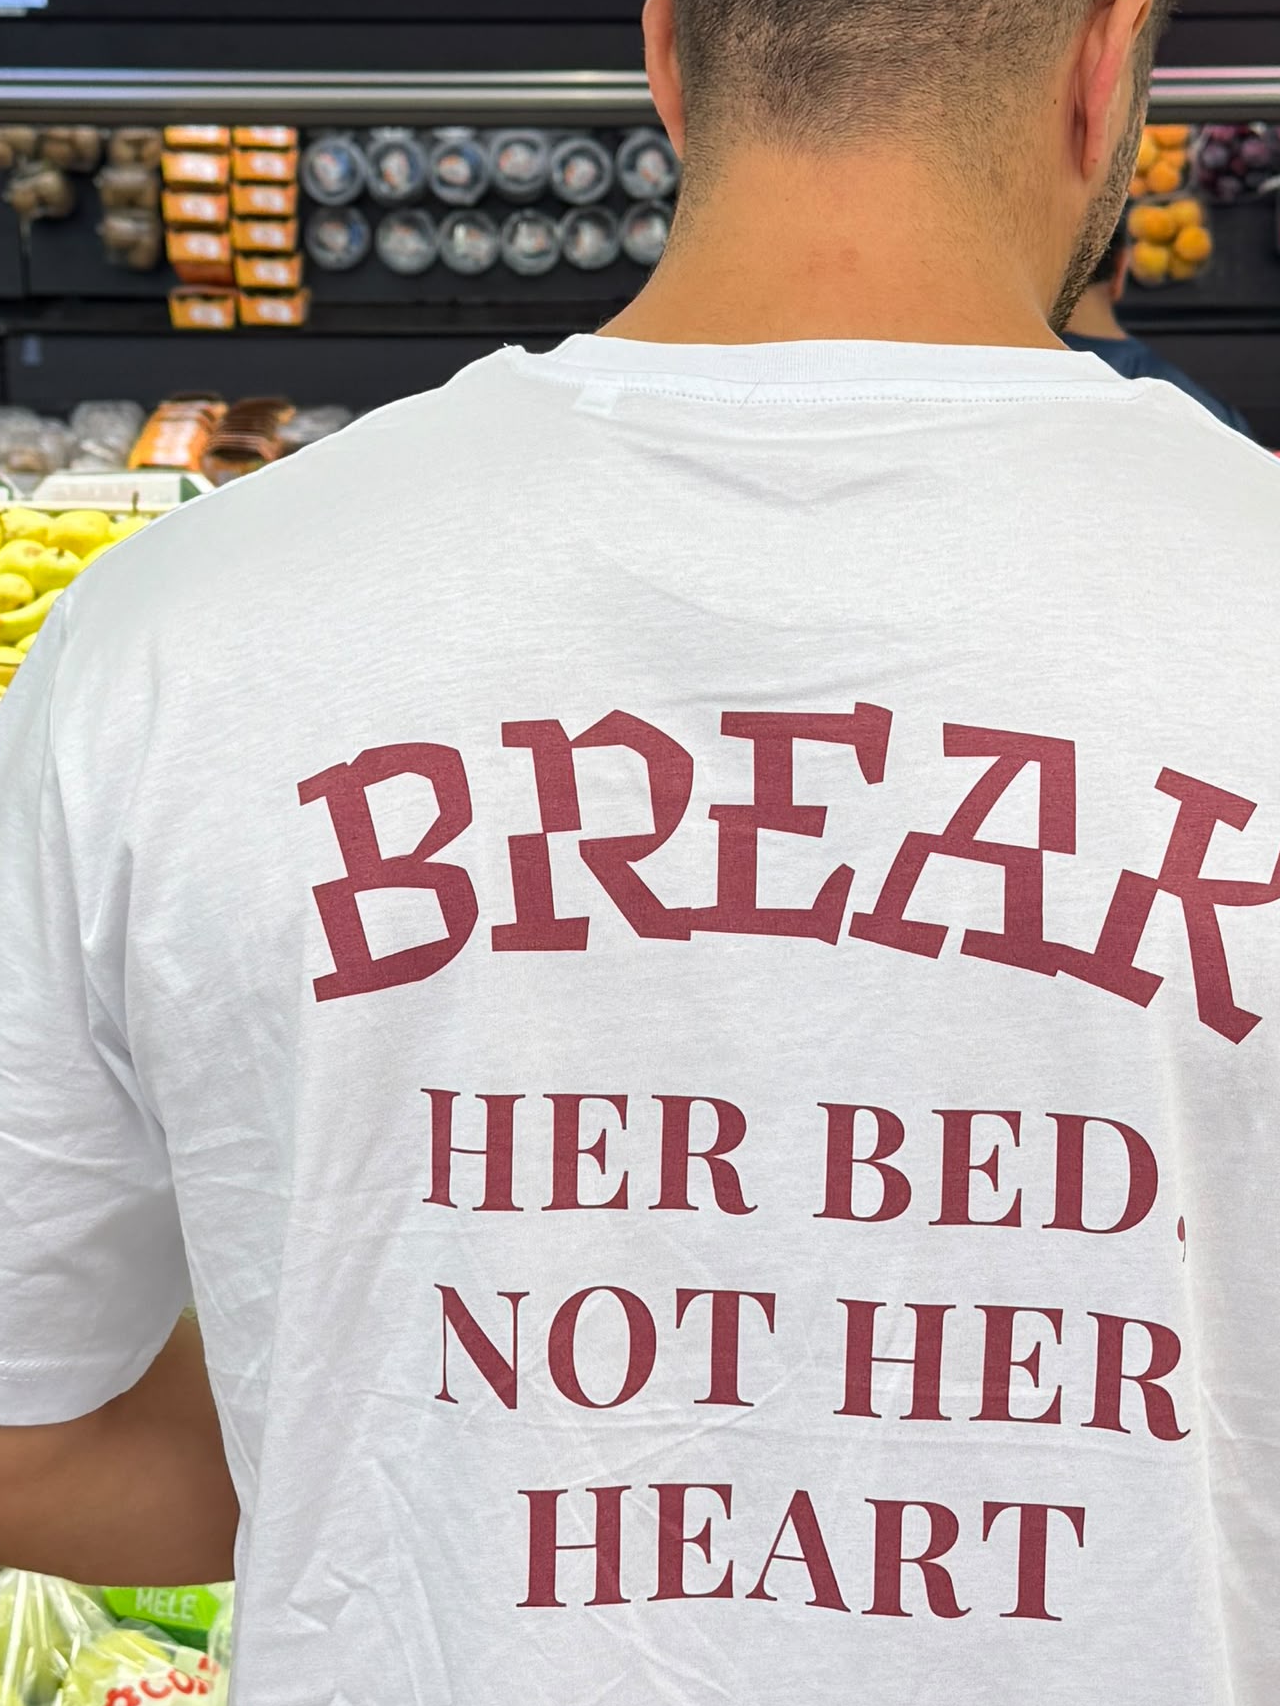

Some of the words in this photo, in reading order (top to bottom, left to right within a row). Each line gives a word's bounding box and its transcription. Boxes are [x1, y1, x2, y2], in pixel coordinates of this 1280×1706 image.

[422, 1087, 759, 1216] HER
[433, 1283, 777, 1410] NOT
[833, 1298, 1192, 1442] HER
[135, 1587, 199, 1621] MELE
[515, 1482, 1087, 1622] HEART
